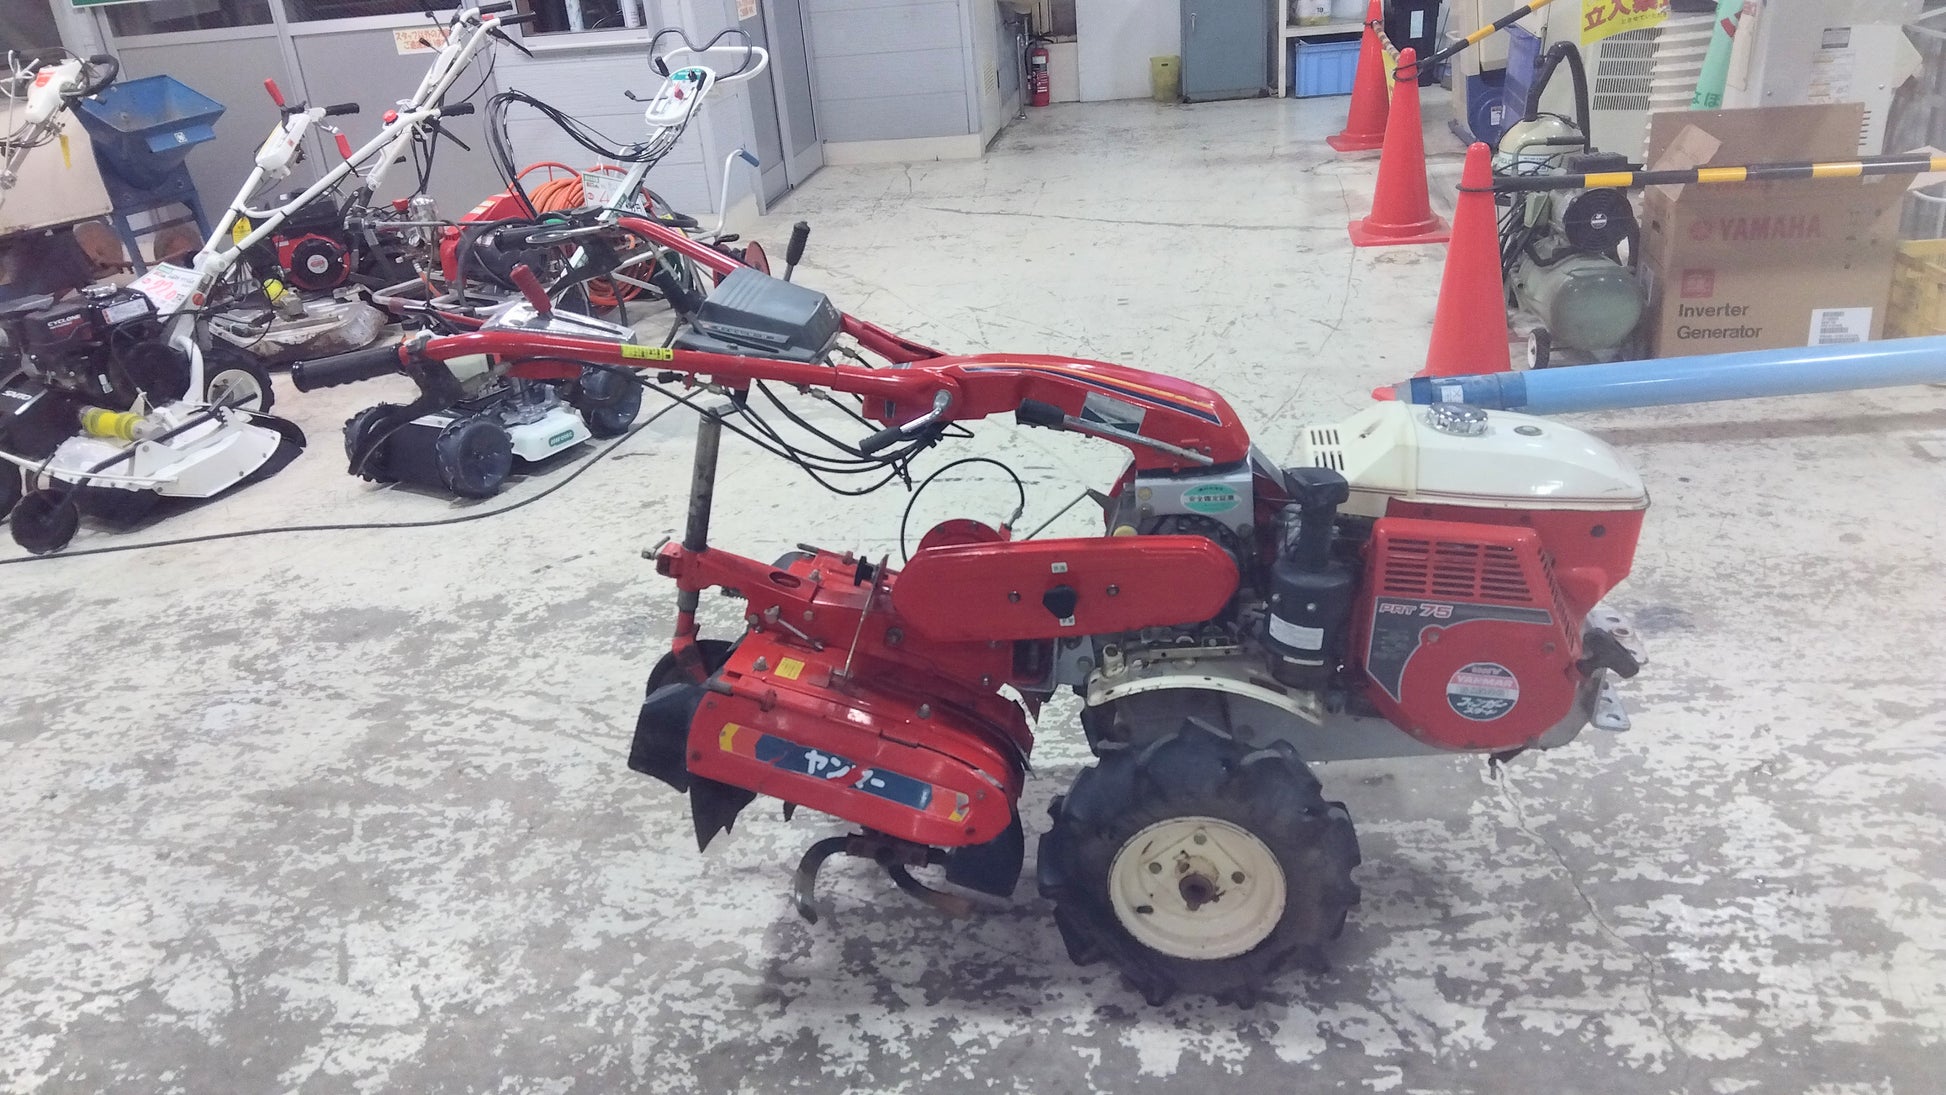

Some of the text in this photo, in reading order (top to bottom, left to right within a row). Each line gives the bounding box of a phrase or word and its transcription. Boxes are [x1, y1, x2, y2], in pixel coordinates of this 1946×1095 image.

[1720, 215, 1821, 241] YAMAHA
[1678, 303, 1749, 318] Inverter
[47, 313, 82, 328] CYCLONE
[1676, 325, 1763, 340] Generator
[1379, 602, 1454, 619] PRT 75
